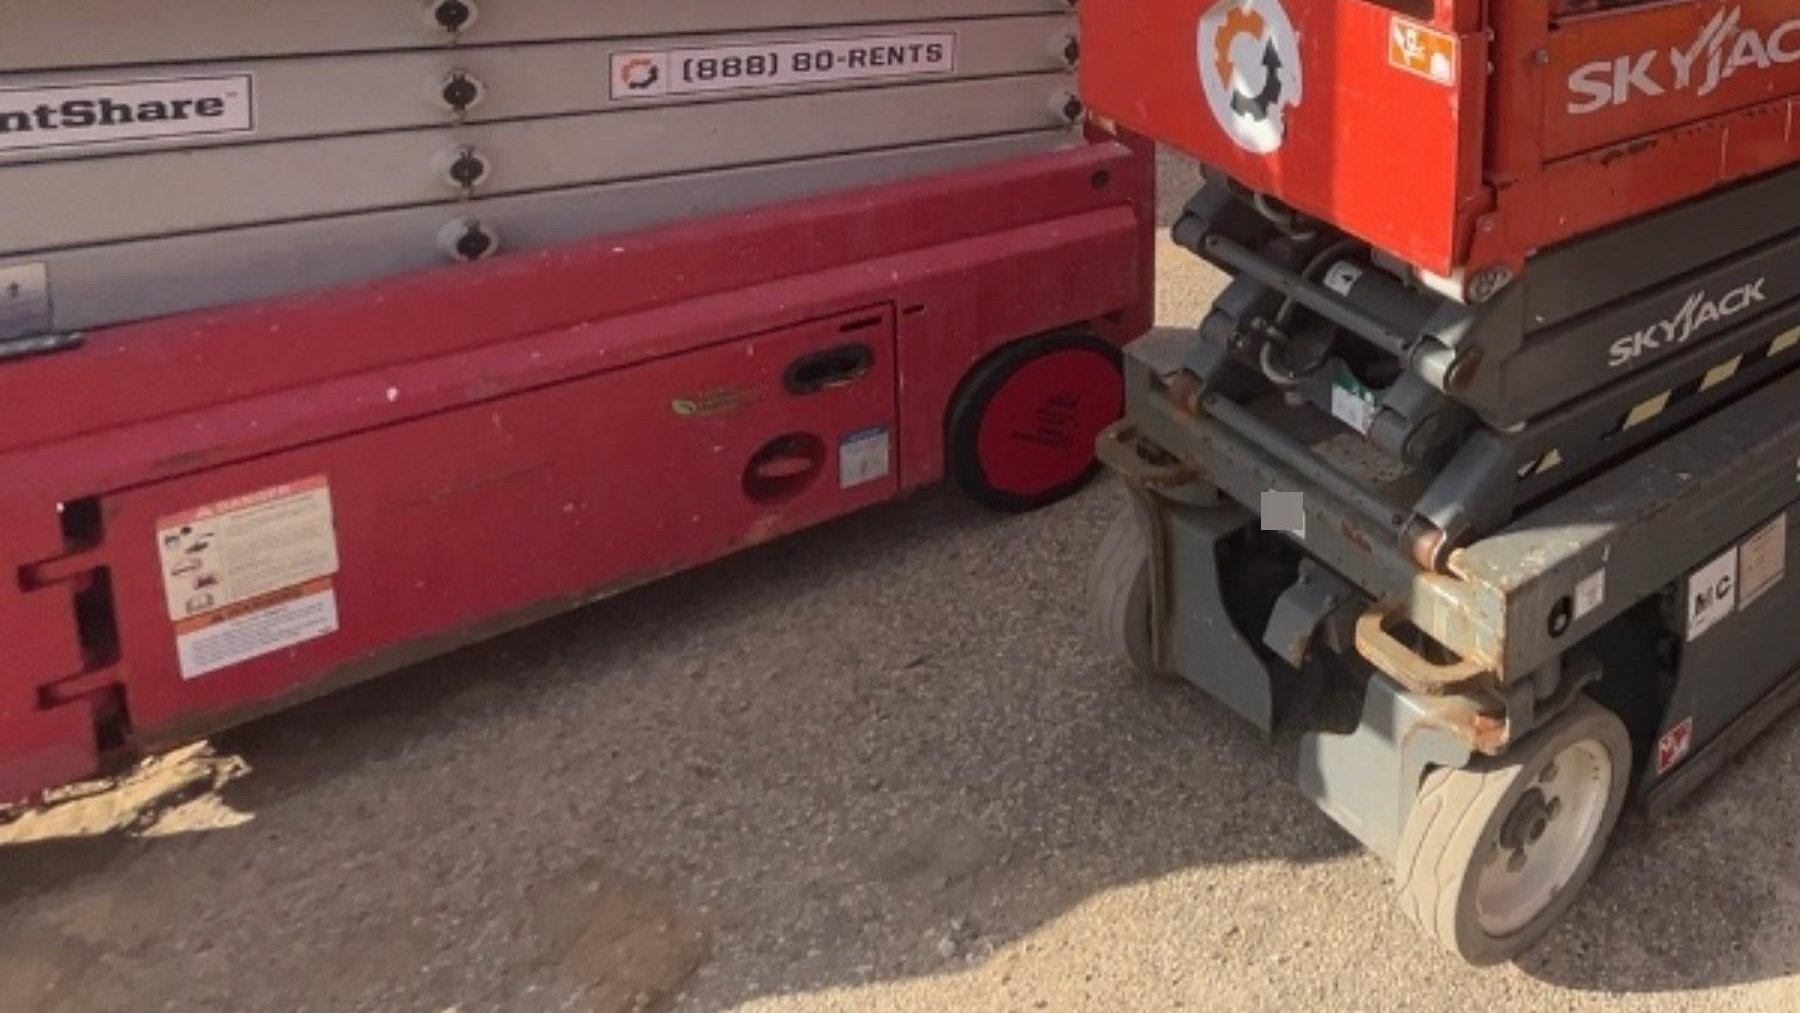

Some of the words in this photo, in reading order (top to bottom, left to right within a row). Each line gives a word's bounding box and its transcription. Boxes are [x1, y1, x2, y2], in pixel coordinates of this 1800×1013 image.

[683, 52, 779, 83] (888)
[791, 43, 944, 73] 80-RENTS
[1608, 277, 1767, 370] SKYJACK
[1694, 574, 1732, 617] MC
